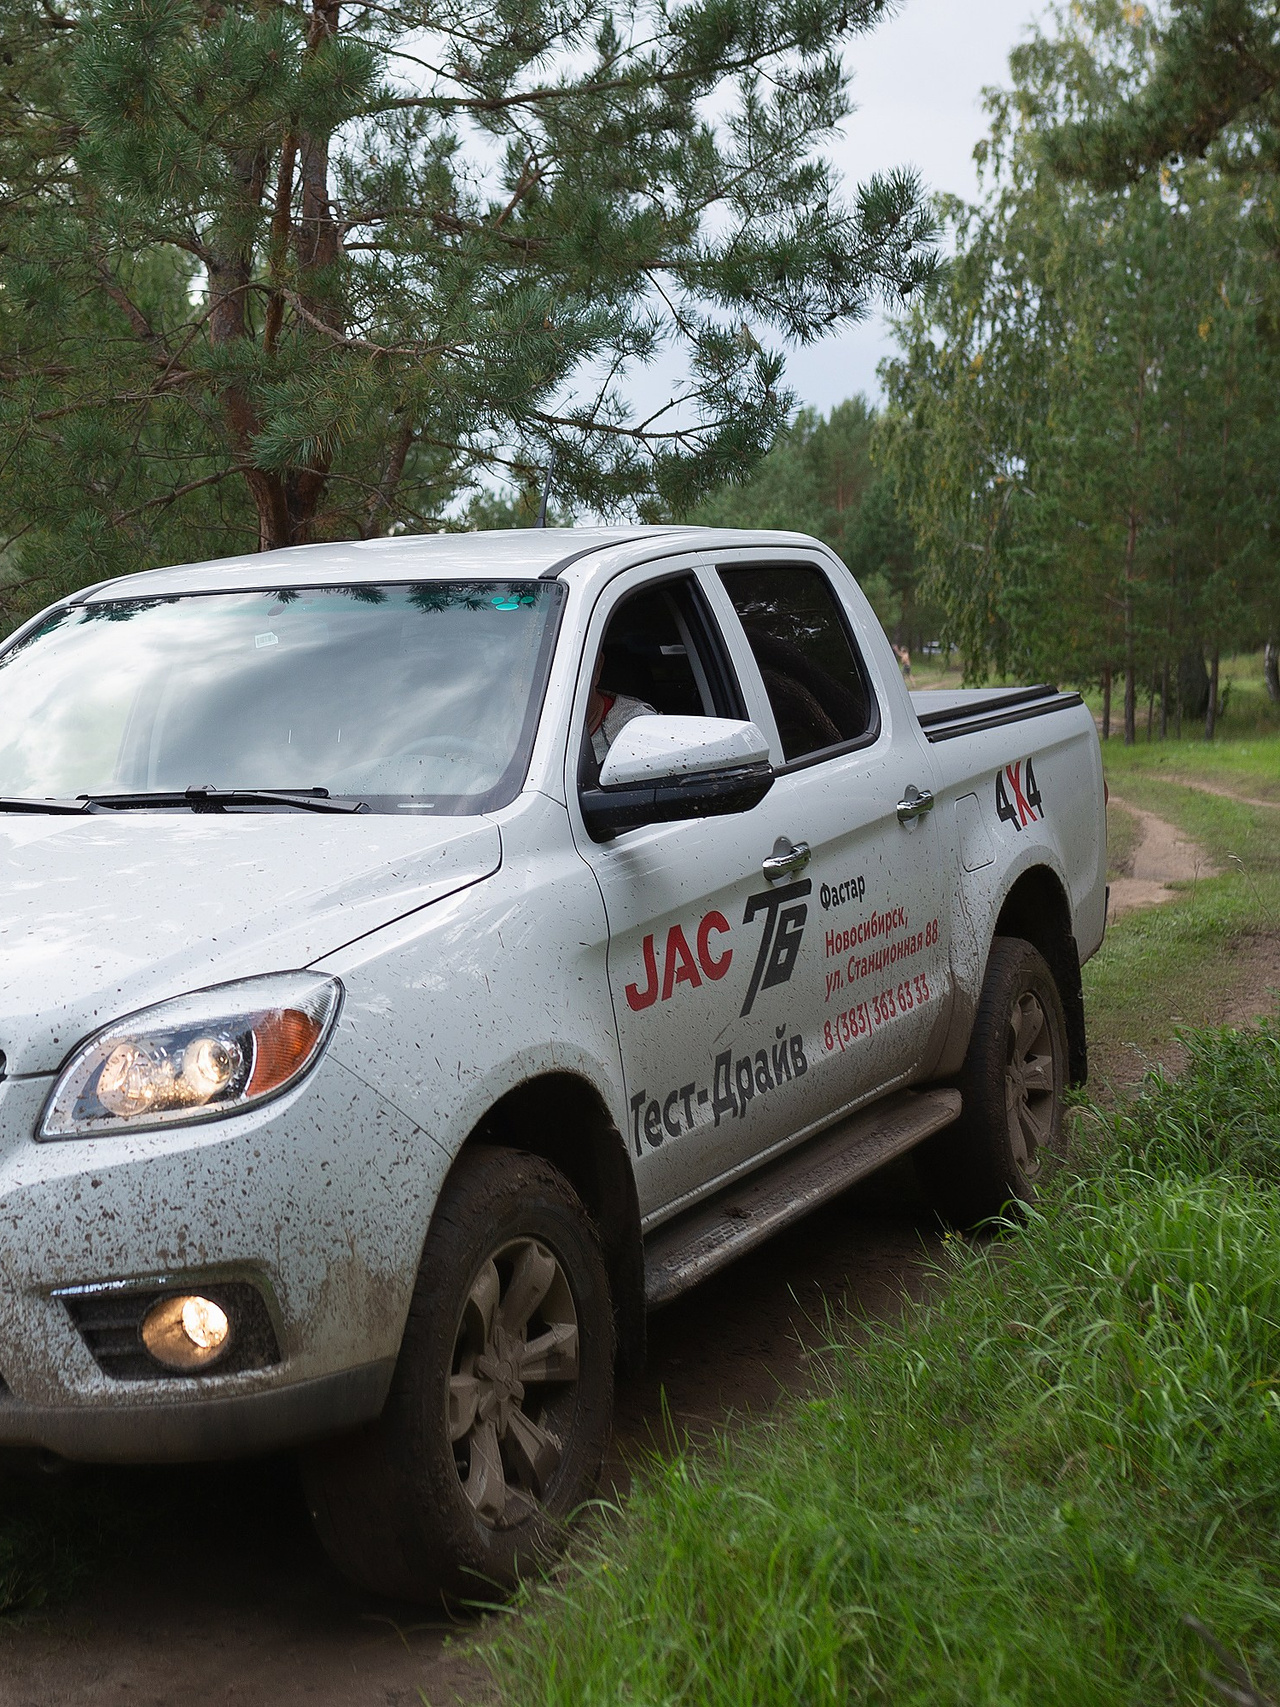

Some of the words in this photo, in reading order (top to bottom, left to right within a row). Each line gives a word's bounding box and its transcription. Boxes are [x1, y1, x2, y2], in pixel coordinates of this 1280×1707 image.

[820, 875, 866, 911] Фастар
[625, 910, 733, 1012] JAC
[825, 906, 909, 958] Новосибирск,
[825, 969, 844, 1003] ул.
[847, 931, 923, 983] Станционная
[925, 918, 939, 948] 88
[872, 988, 897, 1026] 363
[897, 980, 915, 1012] 63
[913, 972, 930, 1004] 33
[630, 1024, 808, 1157] Тест-Драйв
